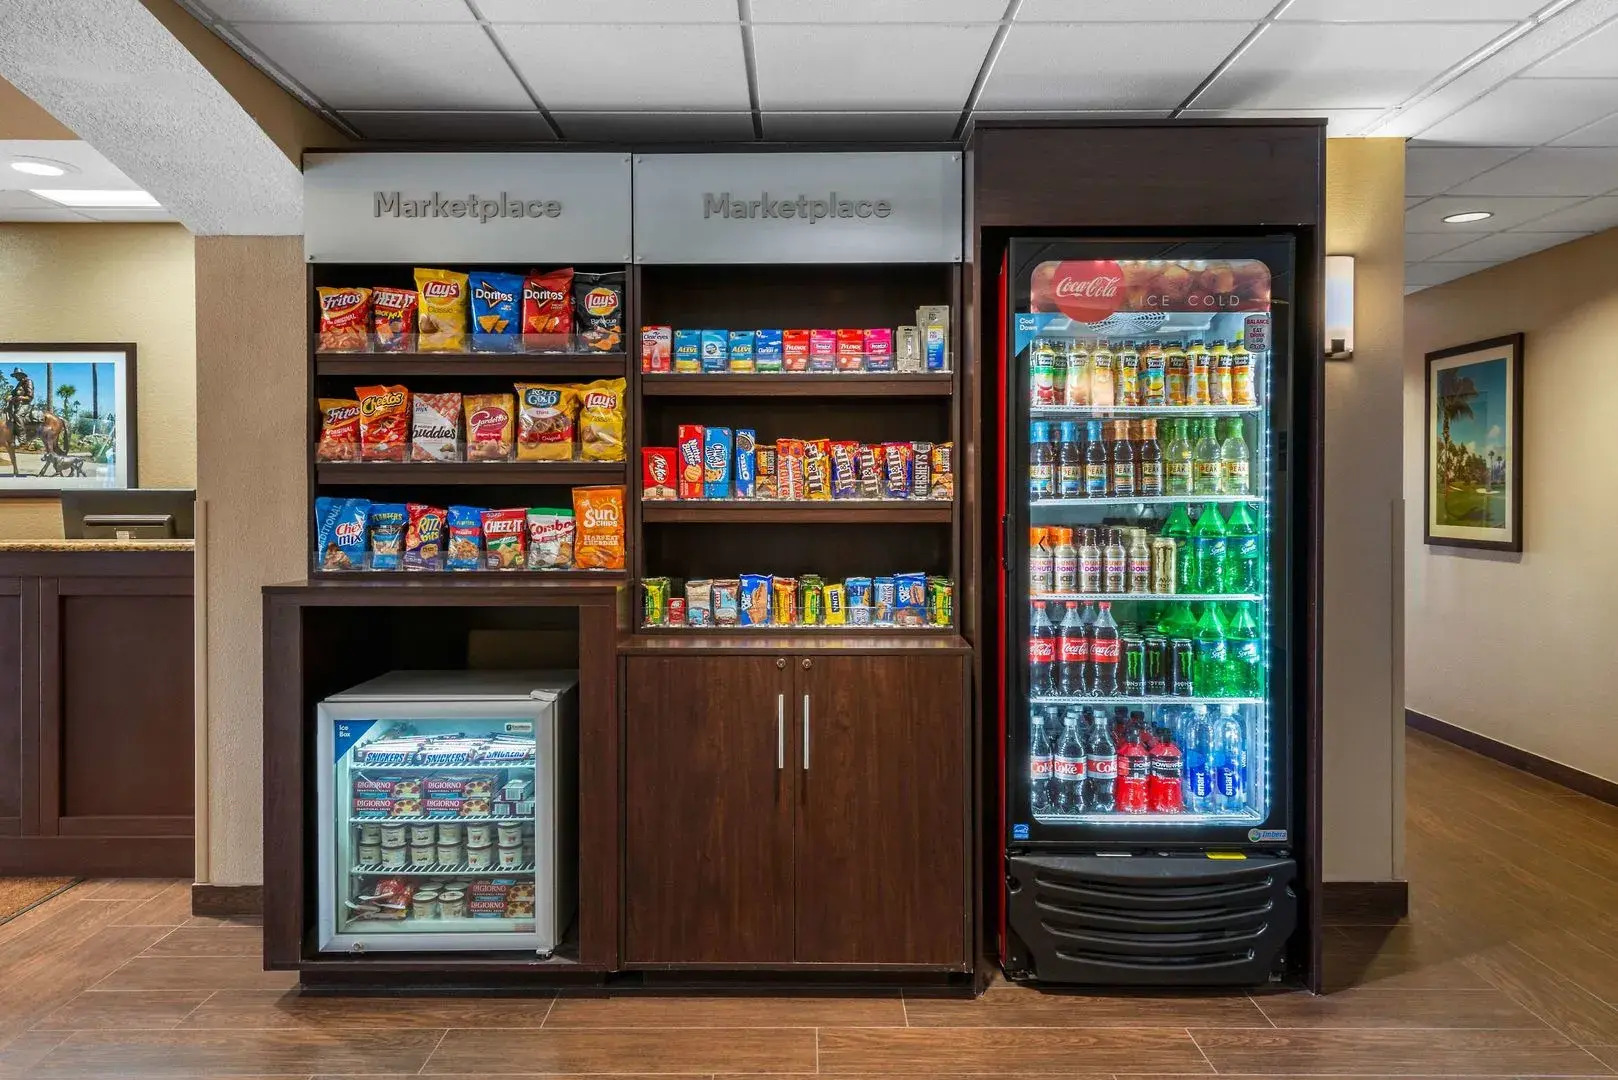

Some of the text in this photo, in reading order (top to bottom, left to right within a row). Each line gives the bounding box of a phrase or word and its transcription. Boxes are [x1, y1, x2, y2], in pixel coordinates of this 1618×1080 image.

[373, 191, 562, 224] Marketplace
[703, 191, 891, 224] Marketplace
[425, 281, 458, 298] Lay's
[475, 288, 513, 302] Doritos
[523, 288, 564, 301] Doritos
[1056, 276, 1120, 298] Coca-Cola
[322, 293, 361, 311] Fritos
[587, 294, 615, 308] Lay's
[1139, 295, 1240, 306] ICE COLD
[361, 392, 403, 415] Cheetos
[586, 393, 616, 411] Lay's
[326, 406, 360, 423] Fritos
[413, 425, 456, 439] buddies
[682, 443, 697, 467] Butter
[689, 438, 702, 463] Nutter
[712, 443, 724, 463] Chips
[914, 453, 928, 496] HERSHEY'S
[335, 509, 365, 538] Chex
[419, 517, 442, 534] RITZ
[484, 518, 524, 534] CHEEZ-IT
[583, 509, 618, 528] Sun
[338, 533, 364, 547] mix
[831, 591, 840, 612] LUNA
[366, 752, 405, 763] SNICKERS
[425, 752, 467, 763] SNICKERS
[1054, 761, 1078, 774] Coke
[1197, 772, 1205, 796] smart
[1225, 774, 1234, 796] smart
